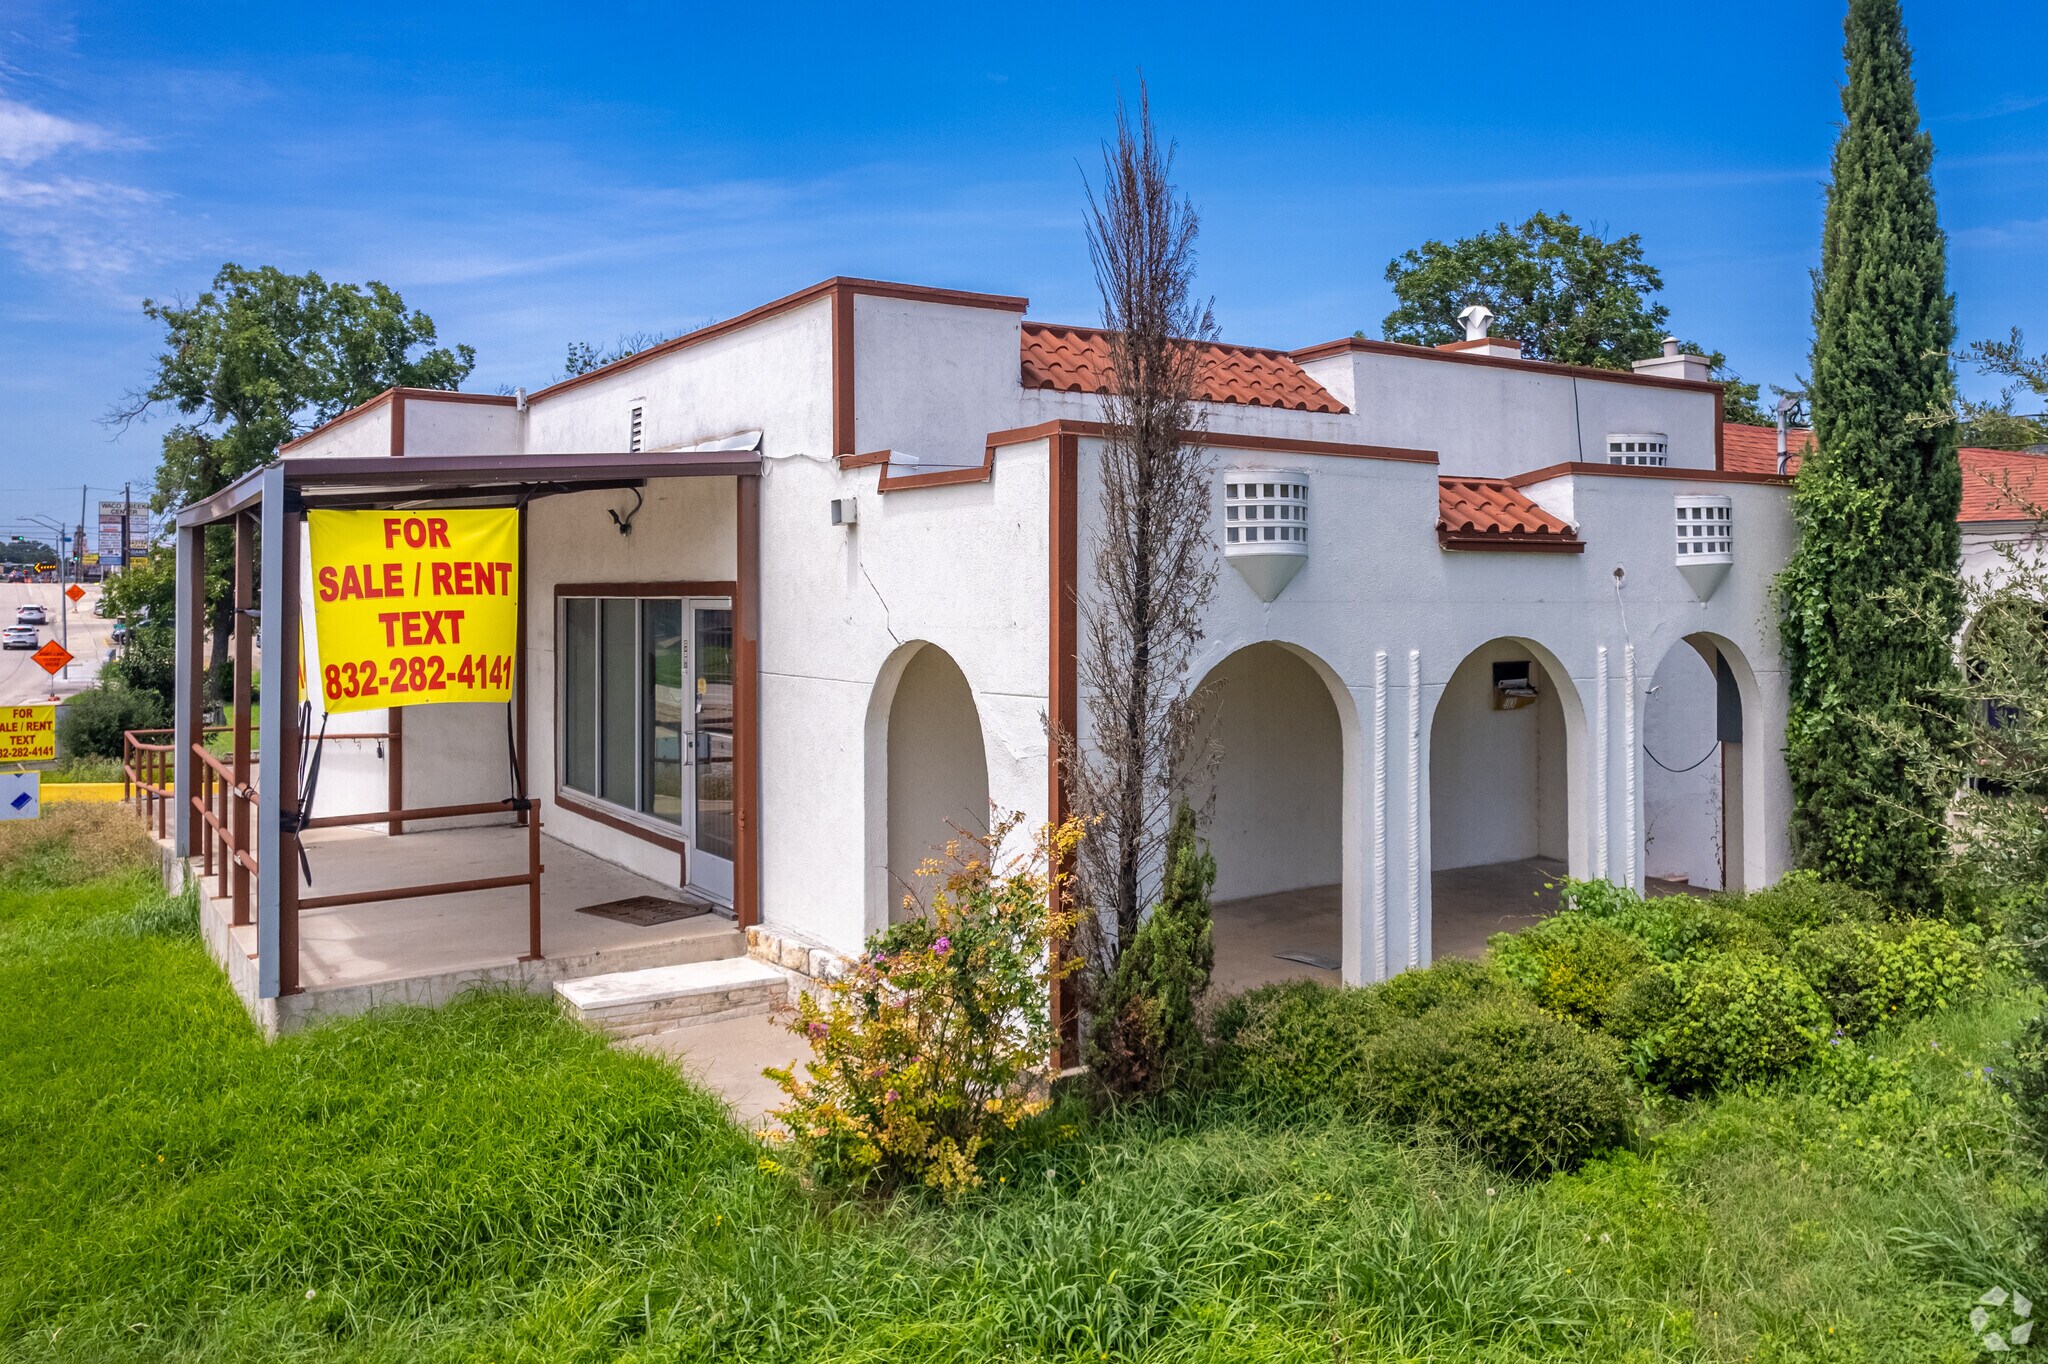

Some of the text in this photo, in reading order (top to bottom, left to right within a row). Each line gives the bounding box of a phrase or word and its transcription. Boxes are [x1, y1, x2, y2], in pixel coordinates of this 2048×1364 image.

[383, 518, 451, 549] FOR
[318, 562, 513, 602] SALE / RENT
[378, 610, 465, 648] TEXT
[325, 655, 512, 700] 832-282-4141
[13, 709, 33, 718] FOR
[0, 722, 18, 732] ALE
[26, 721, 53, 731] RENT
[9, 734, 36, 745] TEXT
[0, 746, 54, 758] 32-282-4141
